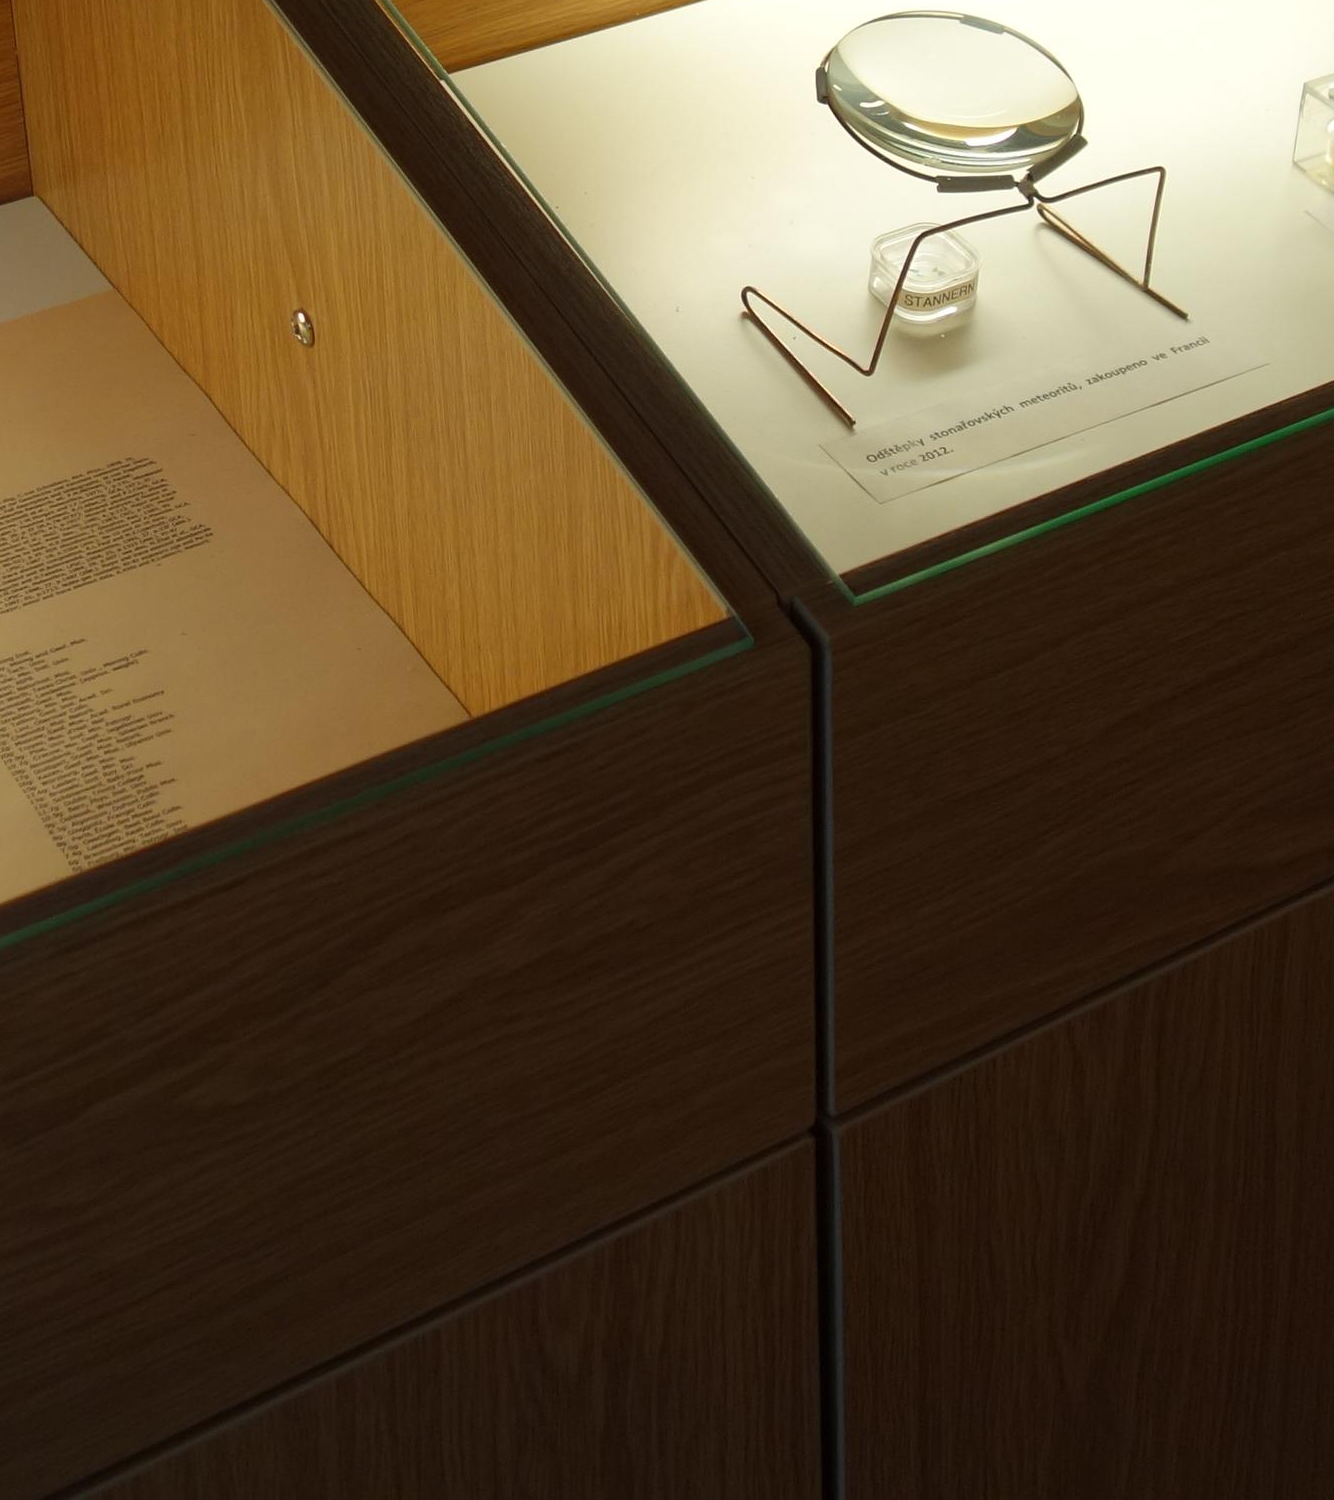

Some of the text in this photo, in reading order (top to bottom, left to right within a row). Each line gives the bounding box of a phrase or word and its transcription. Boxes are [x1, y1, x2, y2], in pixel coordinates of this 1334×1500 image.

[904, 283, 975, 307] STANNERN
[866, 336, 1210, 462] Odštěpky stonařovských meteoritů, zakoupeno Francii
[889, 446, 953, 472] roce 2012.
